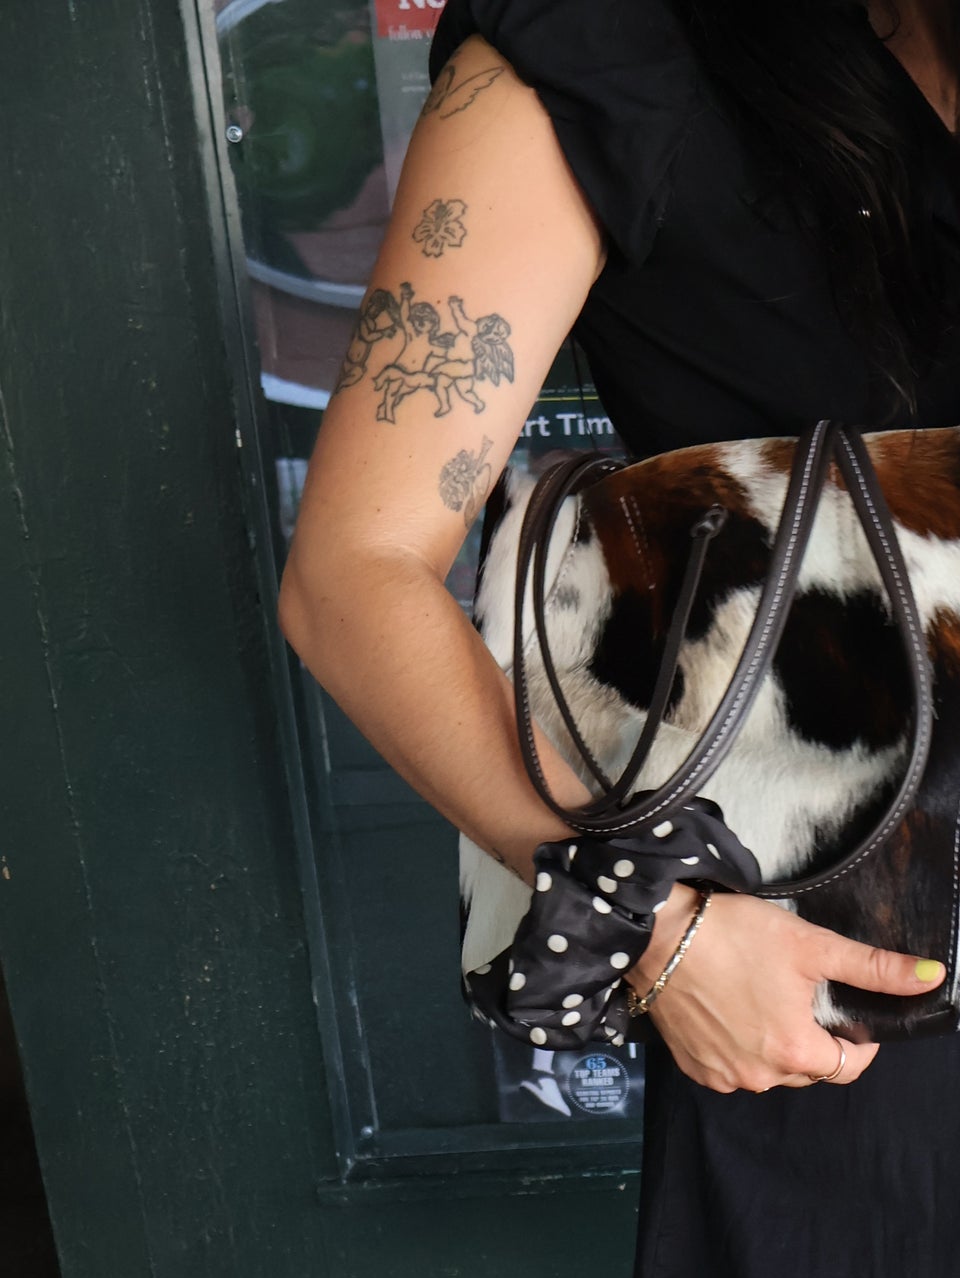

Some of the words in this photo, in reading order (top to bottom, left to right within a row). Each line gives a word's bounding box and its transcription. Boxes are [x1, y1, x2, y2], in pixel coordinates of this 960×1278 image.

[520, 415, 551, 437] rt
[585, 1056, 607, 1070] 65
[574, 1069, 591, 1079] TOP
